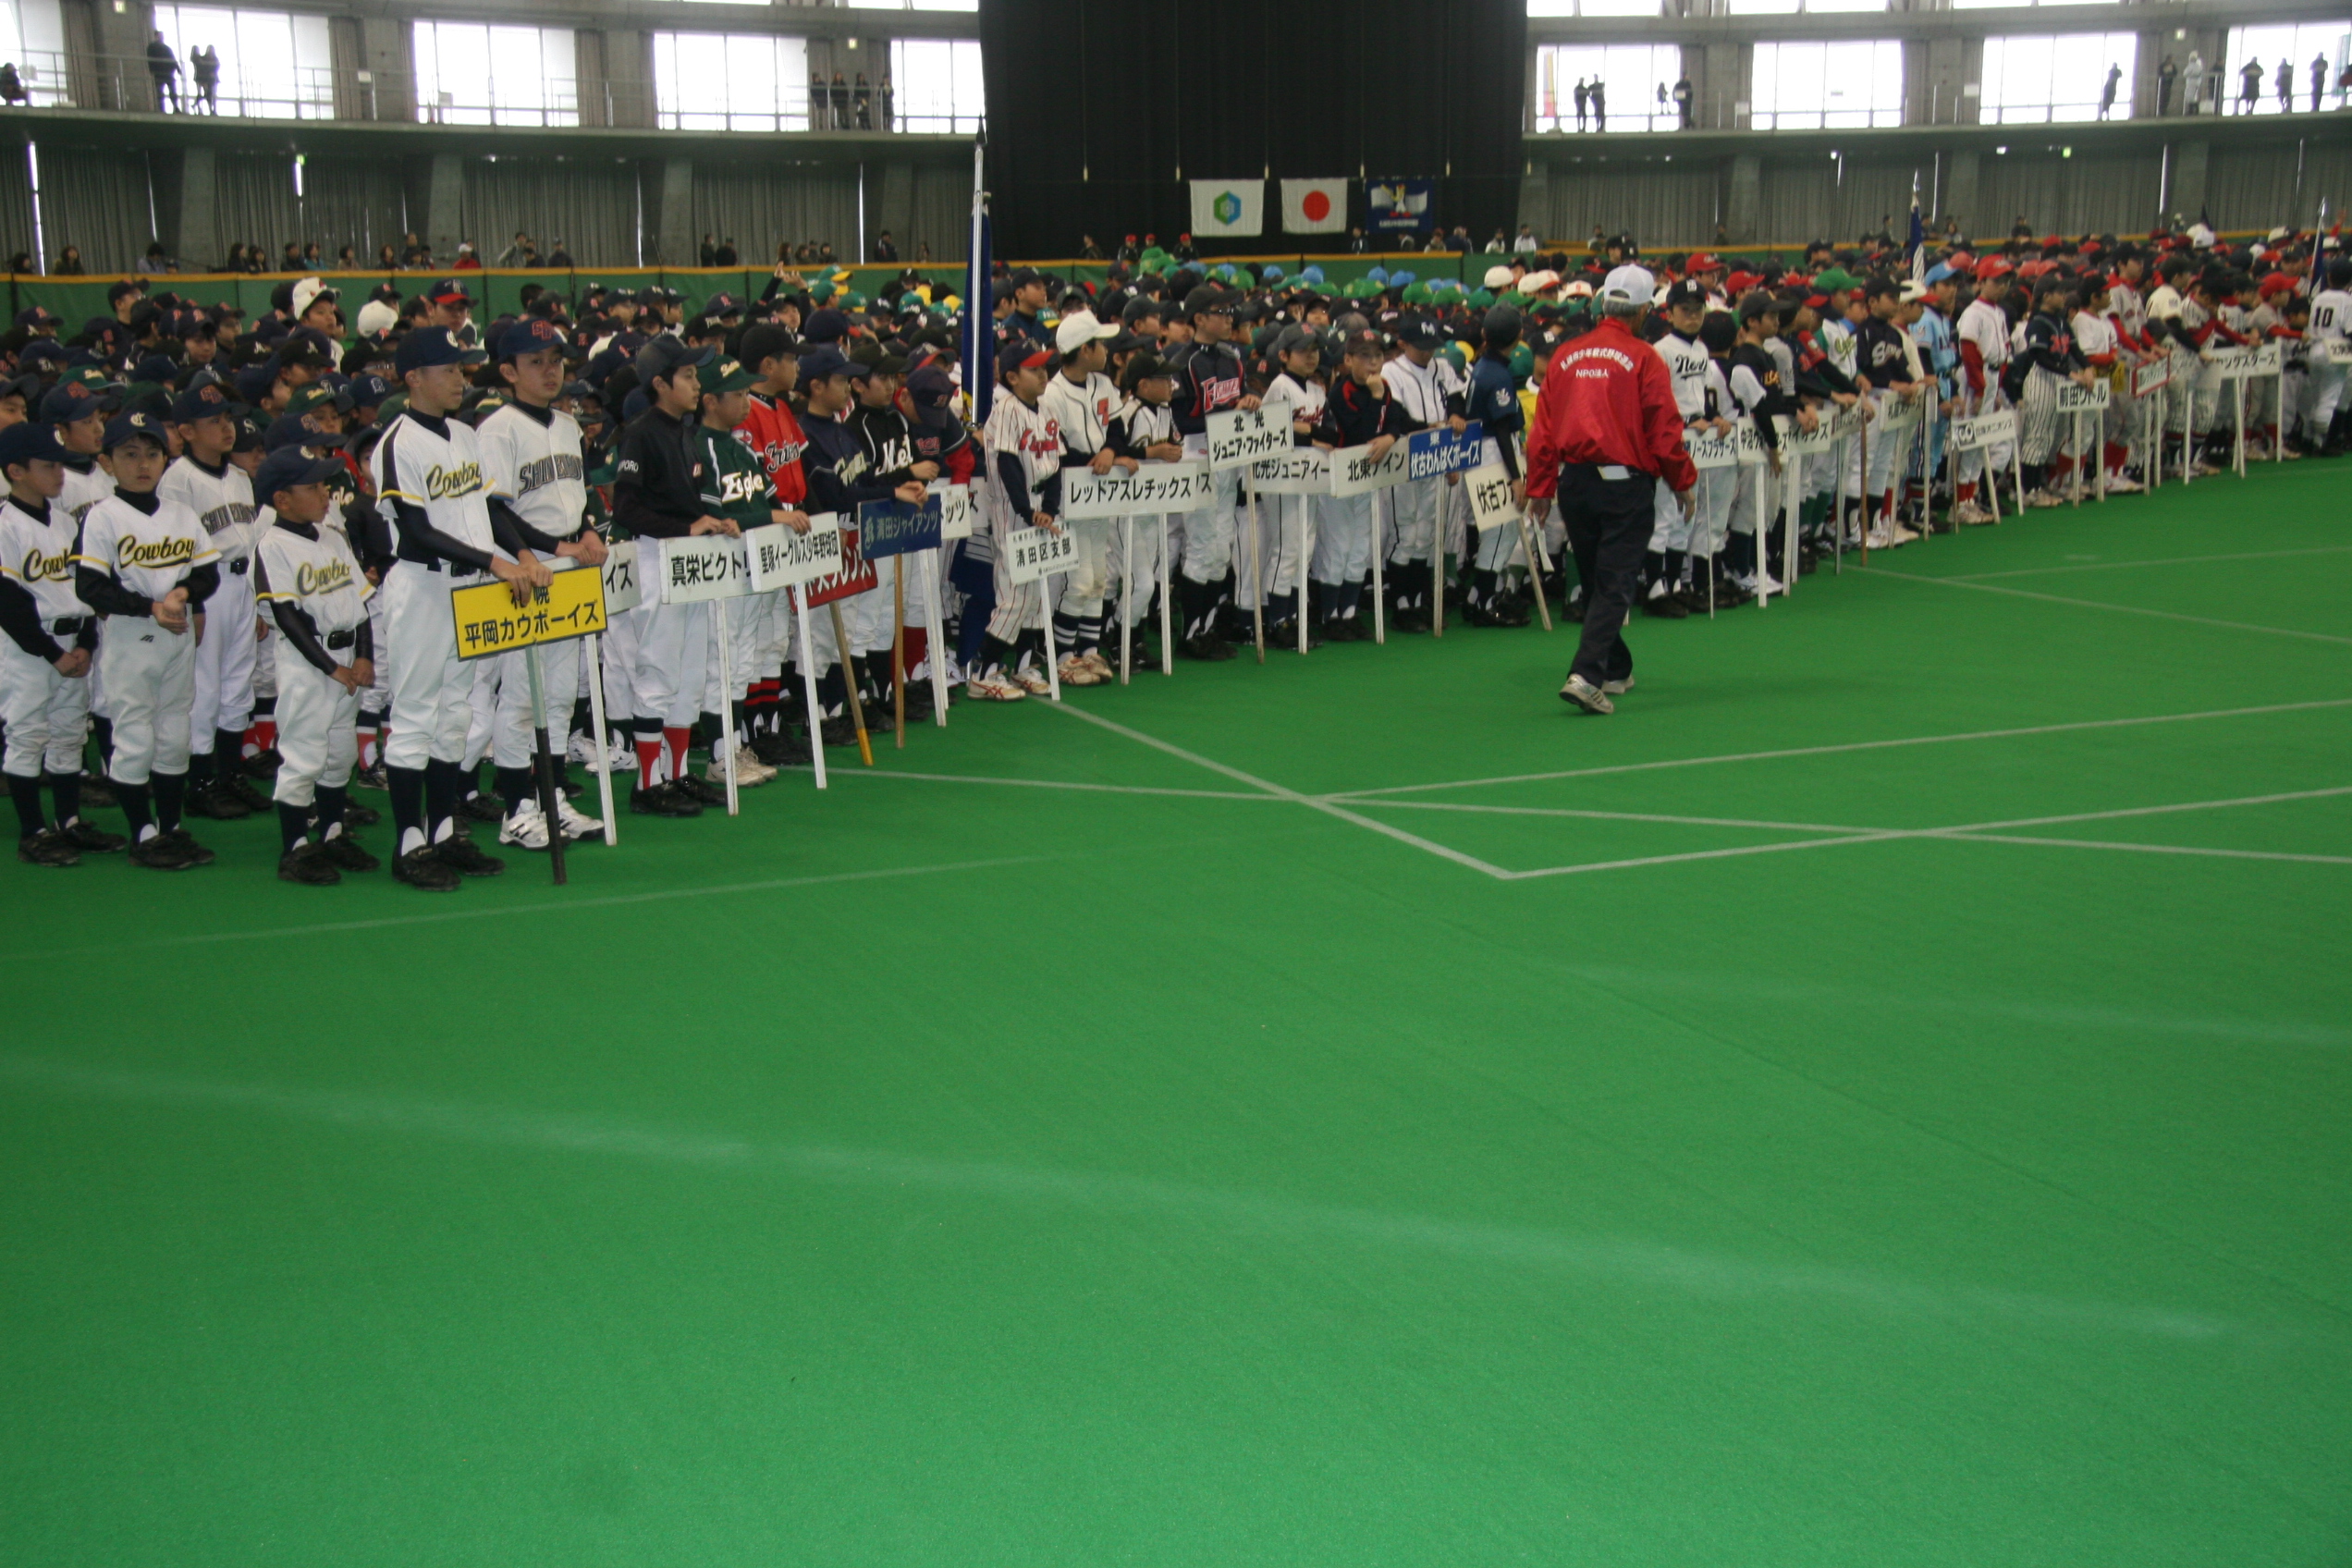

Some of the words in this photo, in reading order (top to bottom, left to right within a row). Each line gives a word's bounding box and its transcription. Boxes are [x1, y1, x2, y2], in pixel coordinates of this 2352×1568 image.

[2314, 307, 2334, 328] 10
[1575, 369, 1609, 379] NPO法人
[1214, 425, 1288, 461] ジュニア・ファイターズ
[1071, 476, 1192, 504] レッドアスレチックス
[940, 499, 966, 524] ッツ
[1016, 536, 1072, 568] 清田区支部
[465, 599, 599, 649] 平岡カウボーイズ
